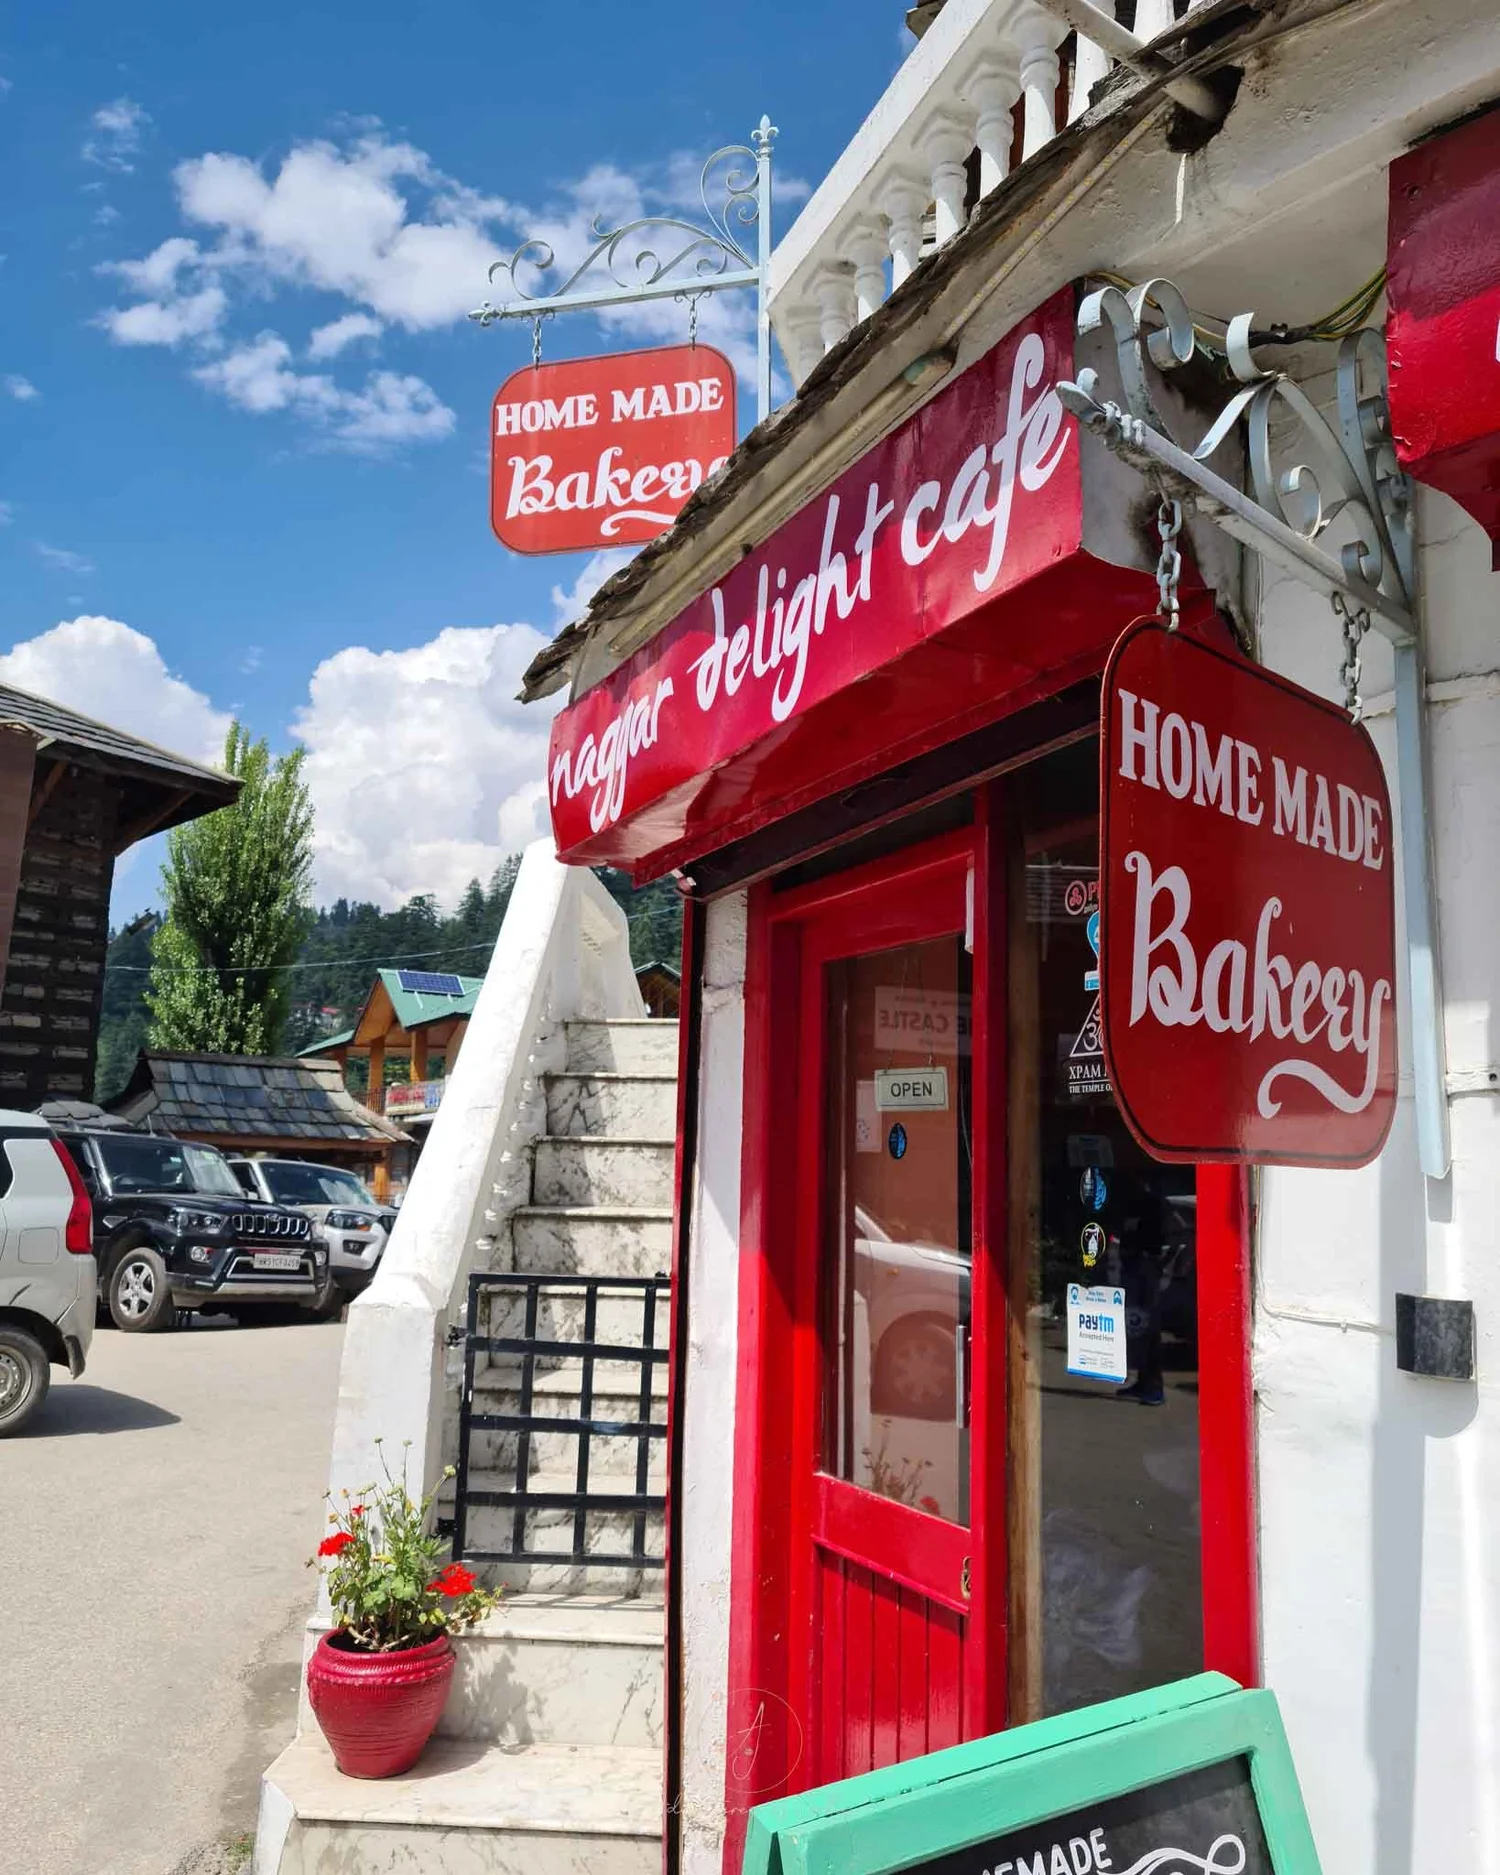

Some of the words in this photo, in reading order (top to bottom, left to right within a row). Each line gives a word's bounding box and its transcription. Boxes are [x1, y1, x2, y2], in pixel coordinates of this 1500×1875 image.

[496, 394, 599, 436] HOME
[610, 377, 725, 423] MADE
[550, 677, 674, 833] naggar
[686, 483, 894, 722] delight
[901, 333, 1071, 592] cafe
[1118, 688, 1264, 826] HOME
[1272, 756, 1384, 871] MADE
[1124, 850, 1391, 1120] Bakery
[890, 1082, 933, 1098] OPEN
[1069, 1063, 1101, 1079] XPAM
[1069, 1085, 1080, 1094] THE
[1082, 1084, 1104, 1093] TEMPLE
[1105, 1083, 1113, 1092] O
